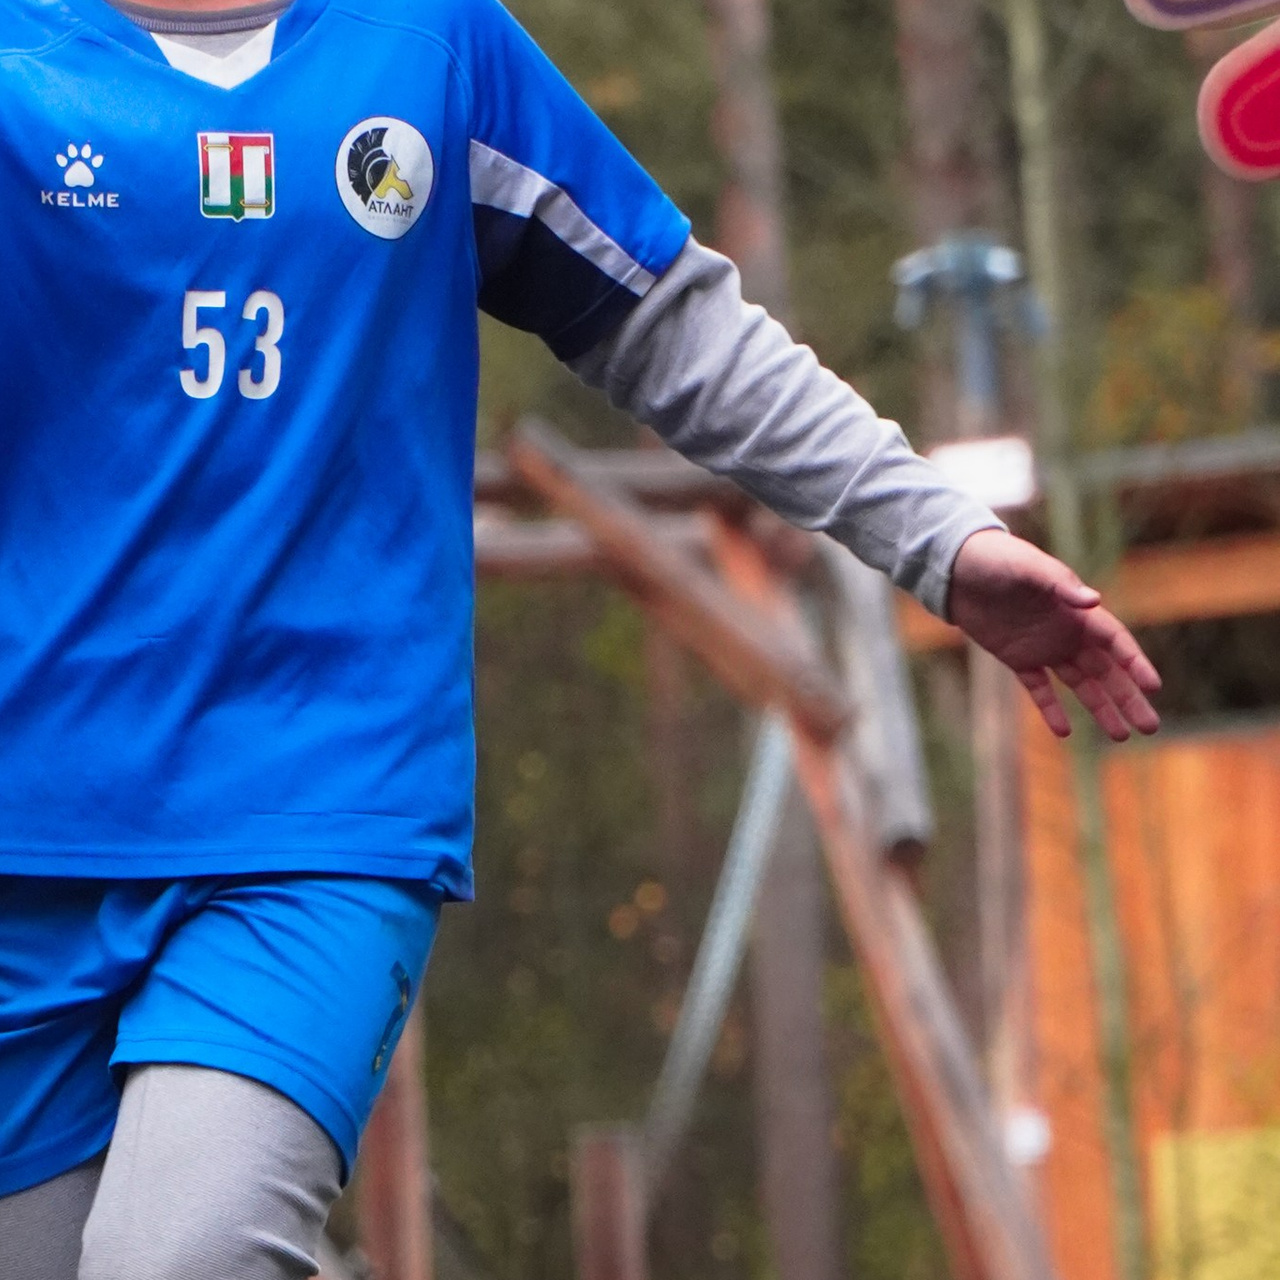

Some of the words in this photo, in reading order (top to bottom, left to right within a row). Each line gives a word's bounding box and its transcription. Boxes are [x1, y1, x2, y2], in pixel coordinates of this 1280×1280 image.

[40, 189, 120, 208] KELME
[368, 200, 414, 218] АТЛАНТ
[179, 290, 285, 400] 53
